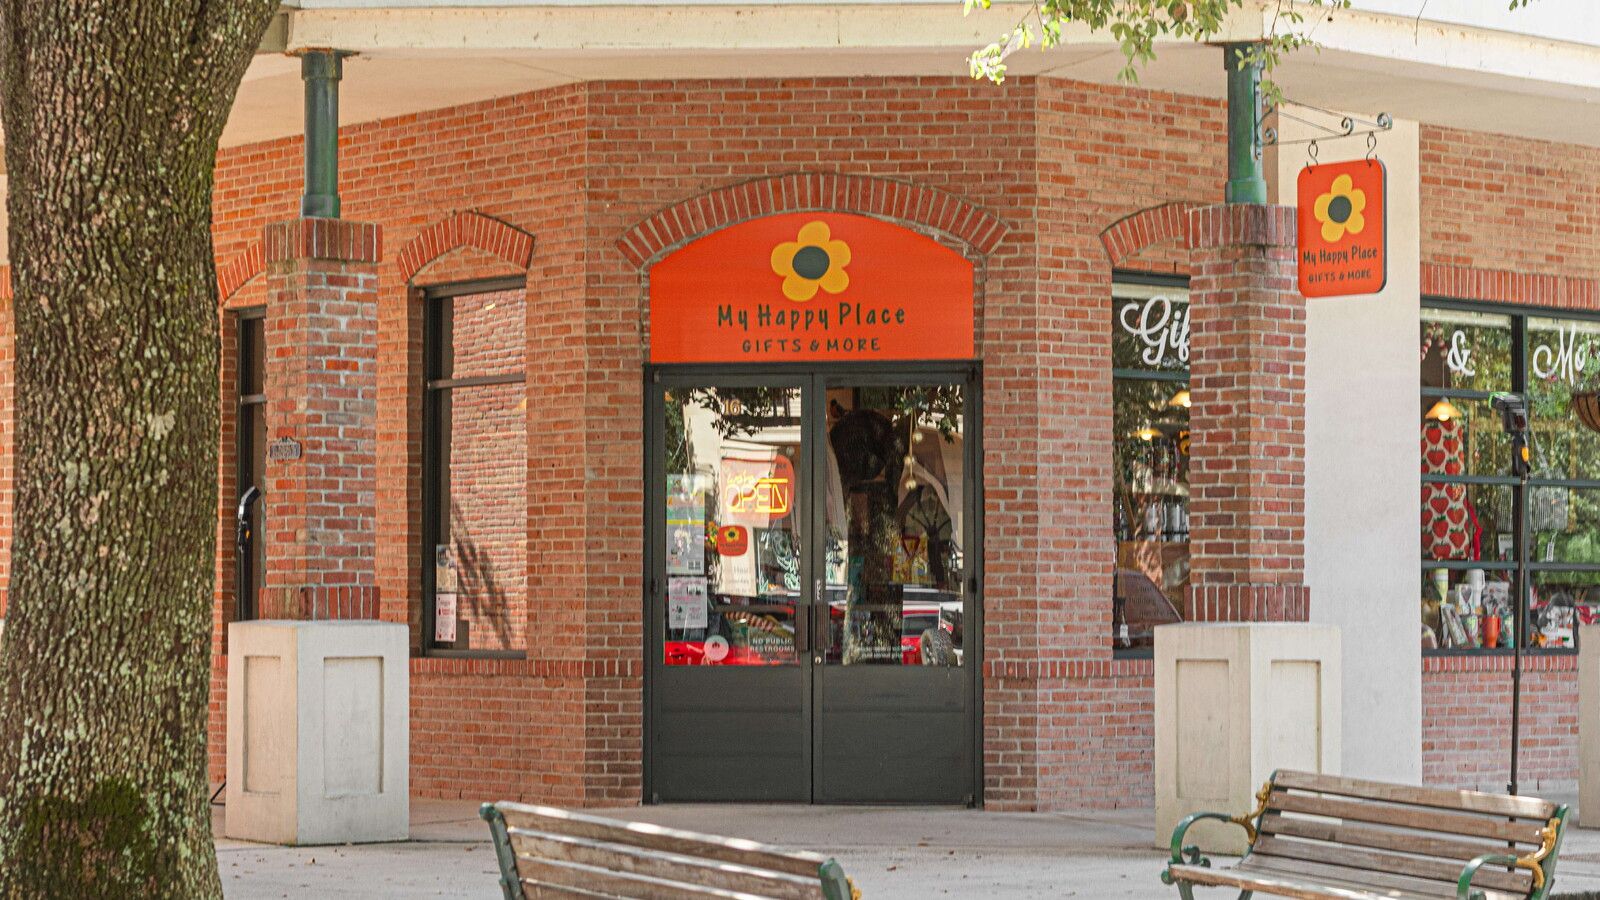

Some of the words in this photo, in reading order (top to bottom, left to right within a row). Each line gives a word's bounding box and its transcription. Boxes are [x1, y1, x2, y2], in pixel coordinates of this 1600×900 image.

[1303, 250, 1316, 267] My
[1320, 248, 1348, 265] Happy
[1352, 245, 1377, 260] Place
[1308, 272, 1335, 283] GIFTS
[1347, 269, 1372, 280] MORE
[718, 304, 748, 331] My
[758, 303, 829, 331] Happy
[838, 302, 906, 326] Place
[742, 338, 801, 353] GIFTS
[810, 338, 819, 352] &
[826, 337, 881, 352] MORE
[1447, 330, 1475, 377] &
[725, 483, 788, 509] OPEN
